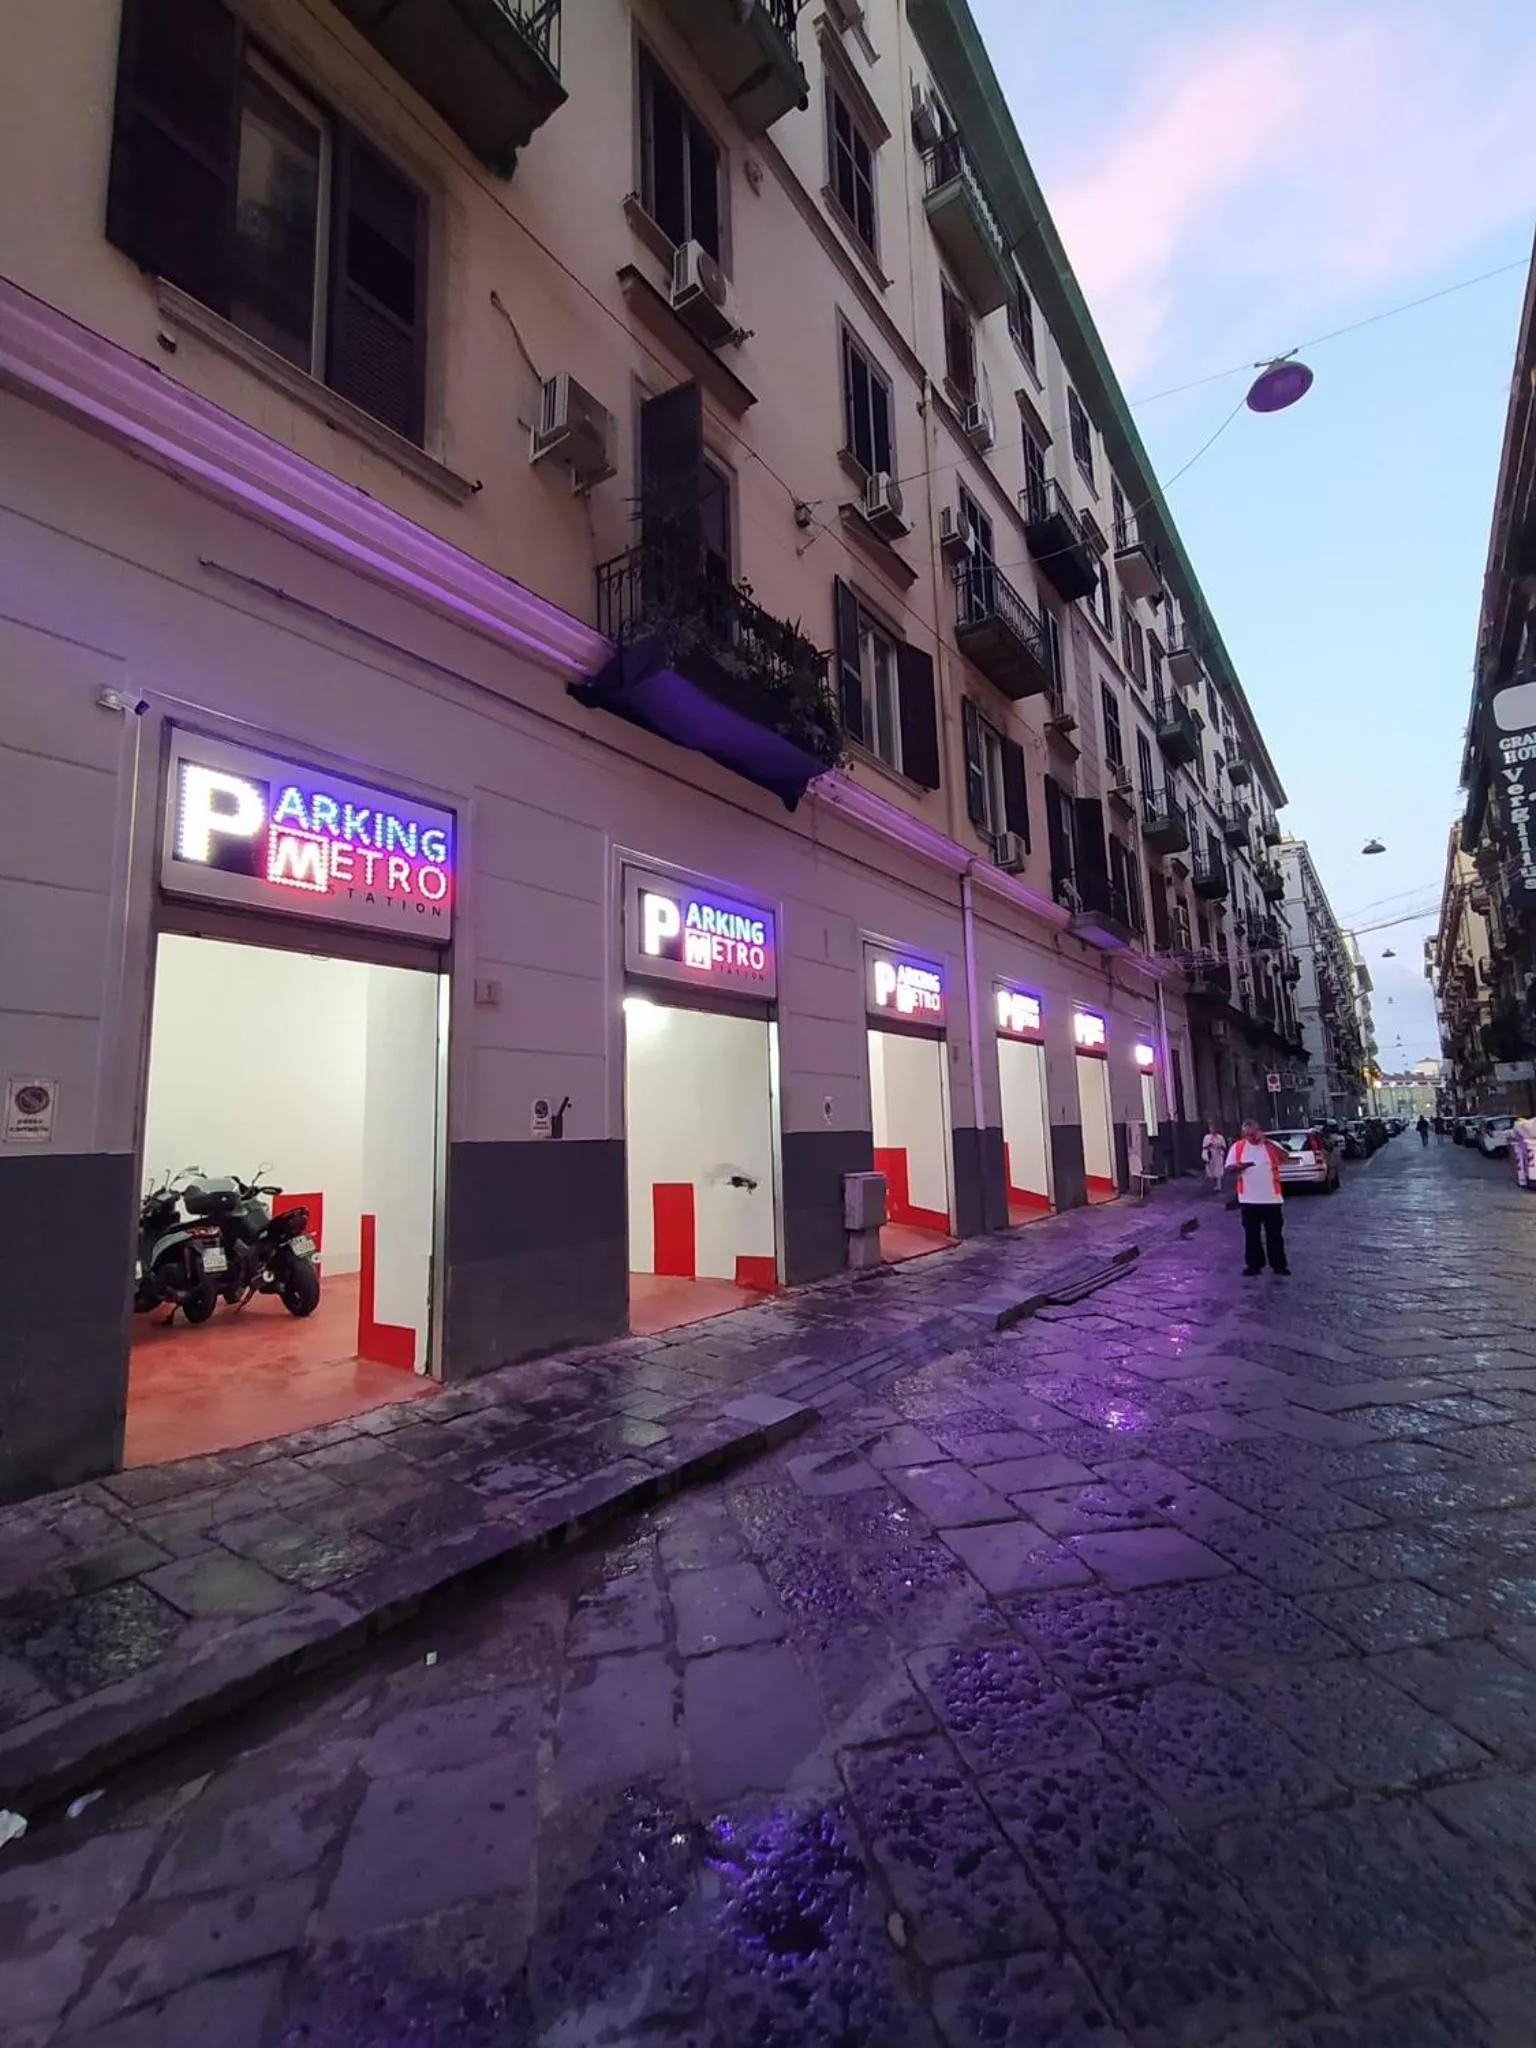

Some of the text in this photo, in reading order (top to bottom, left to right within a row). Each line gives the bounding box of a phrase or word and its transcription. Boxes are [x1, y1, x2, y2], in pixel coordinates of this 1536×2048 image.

[1501, 766, 1536, 889] Vergilius
[268, 824, 448, 901] METRO
[327, 885, 443, 917] STATION
[685, 928, 765, 971] METRO
